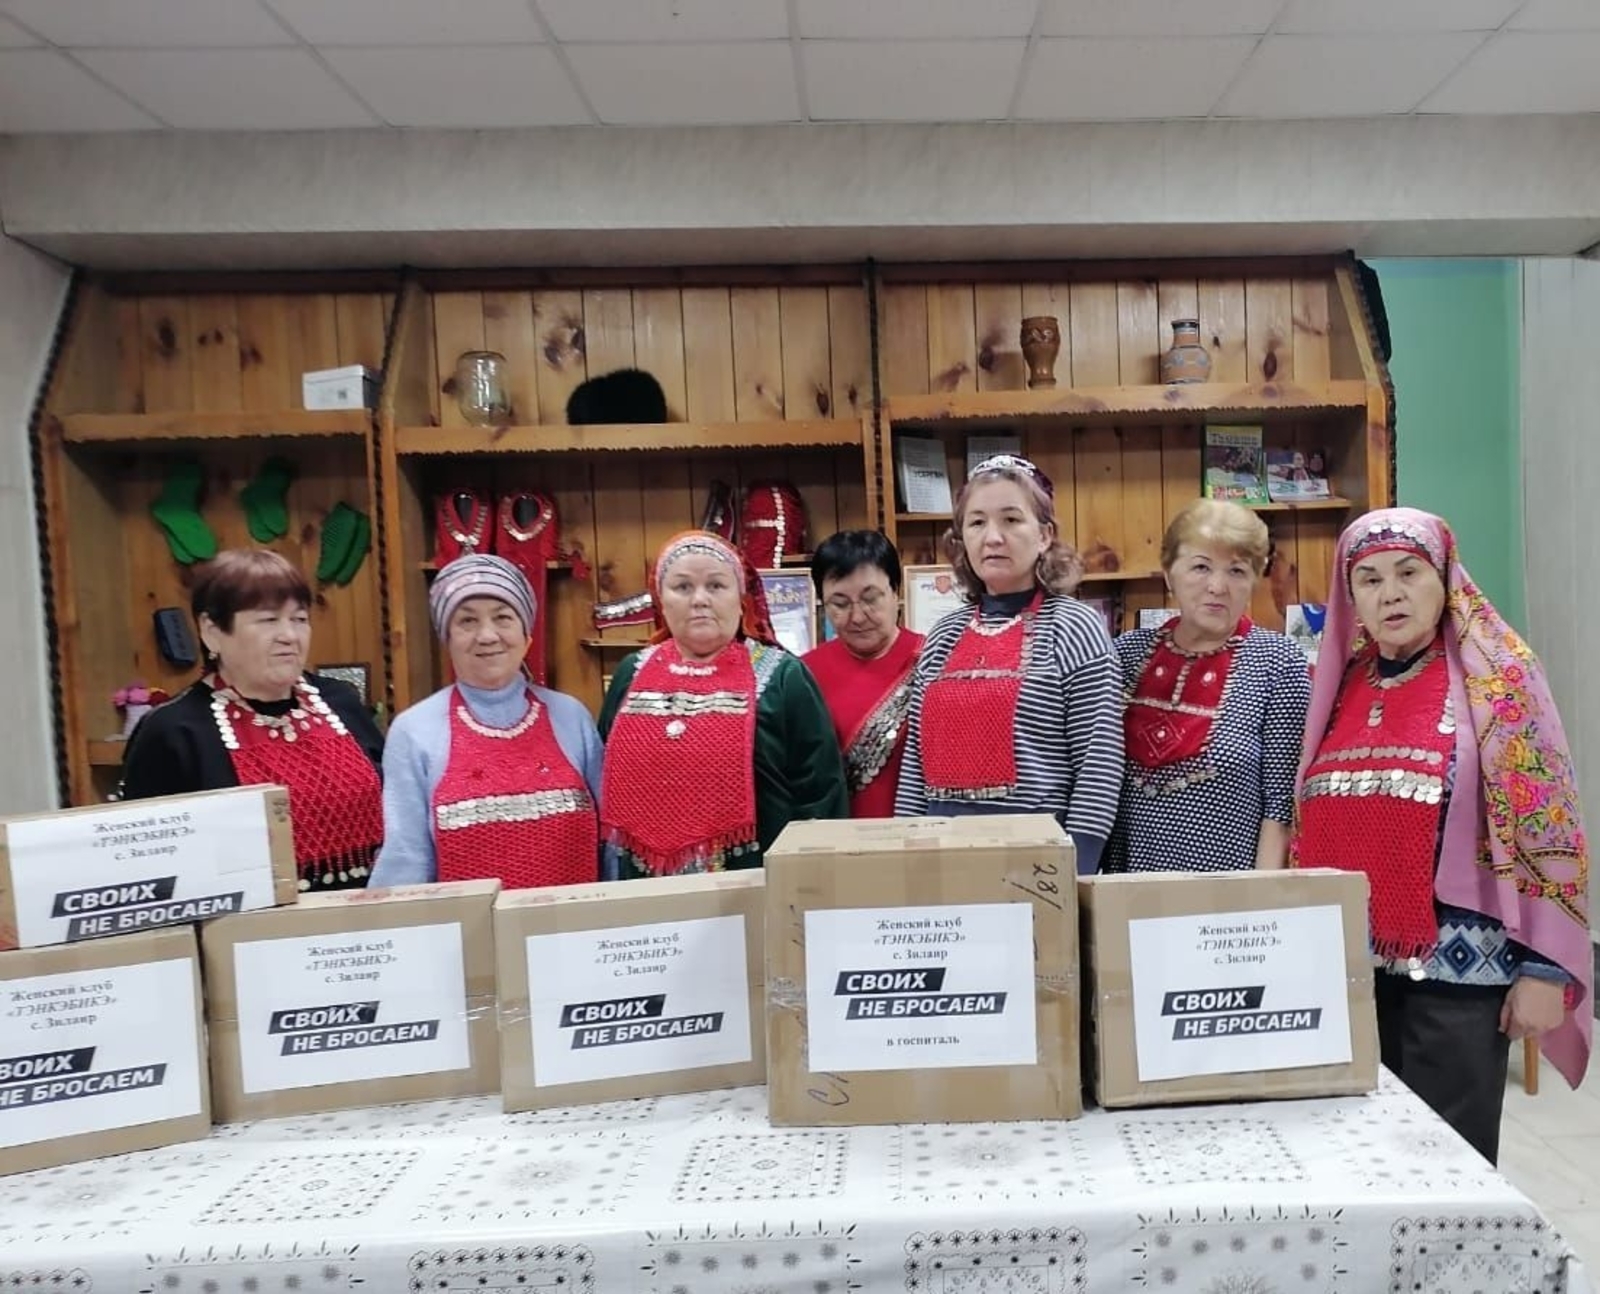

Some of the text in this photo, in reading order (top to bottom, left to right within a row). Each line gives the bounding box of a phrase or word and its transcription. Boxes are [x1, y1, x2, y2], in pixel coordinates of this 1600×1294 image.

[94, 811, 191, 833] Женский клуб
[130, 844, 177, 860] Зилаир
[63, 881, 158, 912] СВОИХ
[79, 896, 233, 935] НЕ БРОСАЕМ
[877, 916, 963, 931] Женский клуб
[1198, 921, 1278, 936] Женский клуб
[307, 939, 394, 957] Женский клуб
[597, 932, 680, 951] Женский клуб
[906, 948, 948, 961] Зилаир
[1227, 952, 1266, 965] Зилаир
[339, 969, 380, 983] Зилаир
[627, 964, 667, 977] Зилаир
[11, 980, 113, 1001] Женский клуб
[846, 971, 928, 992] СВОИХ
[857, 995, 995, 1016] НЕ БРОСАЕМ
[1171, 989, 1248, 1012] СВОИХ
[46, 1014, 98, 1029] Зилаир
[279, 1003, 362, 1029] СВОИХ
[570, 999, 649, 1024] СВОИХ
[582, 1016, 713, 1045] НЕ БРОСАЕМ
[1183, 1011, 1312, 1036] НЕ БРОСАЕМ
[293, 1024, 429, 1051] НЕ БРОСАЕМ
[887, 1035, 960, 1047] в госпиталь
[0, 1053, 75, 1081] ВОИХ
[32, 1068, 155, 1101] БРОСАЕМ
